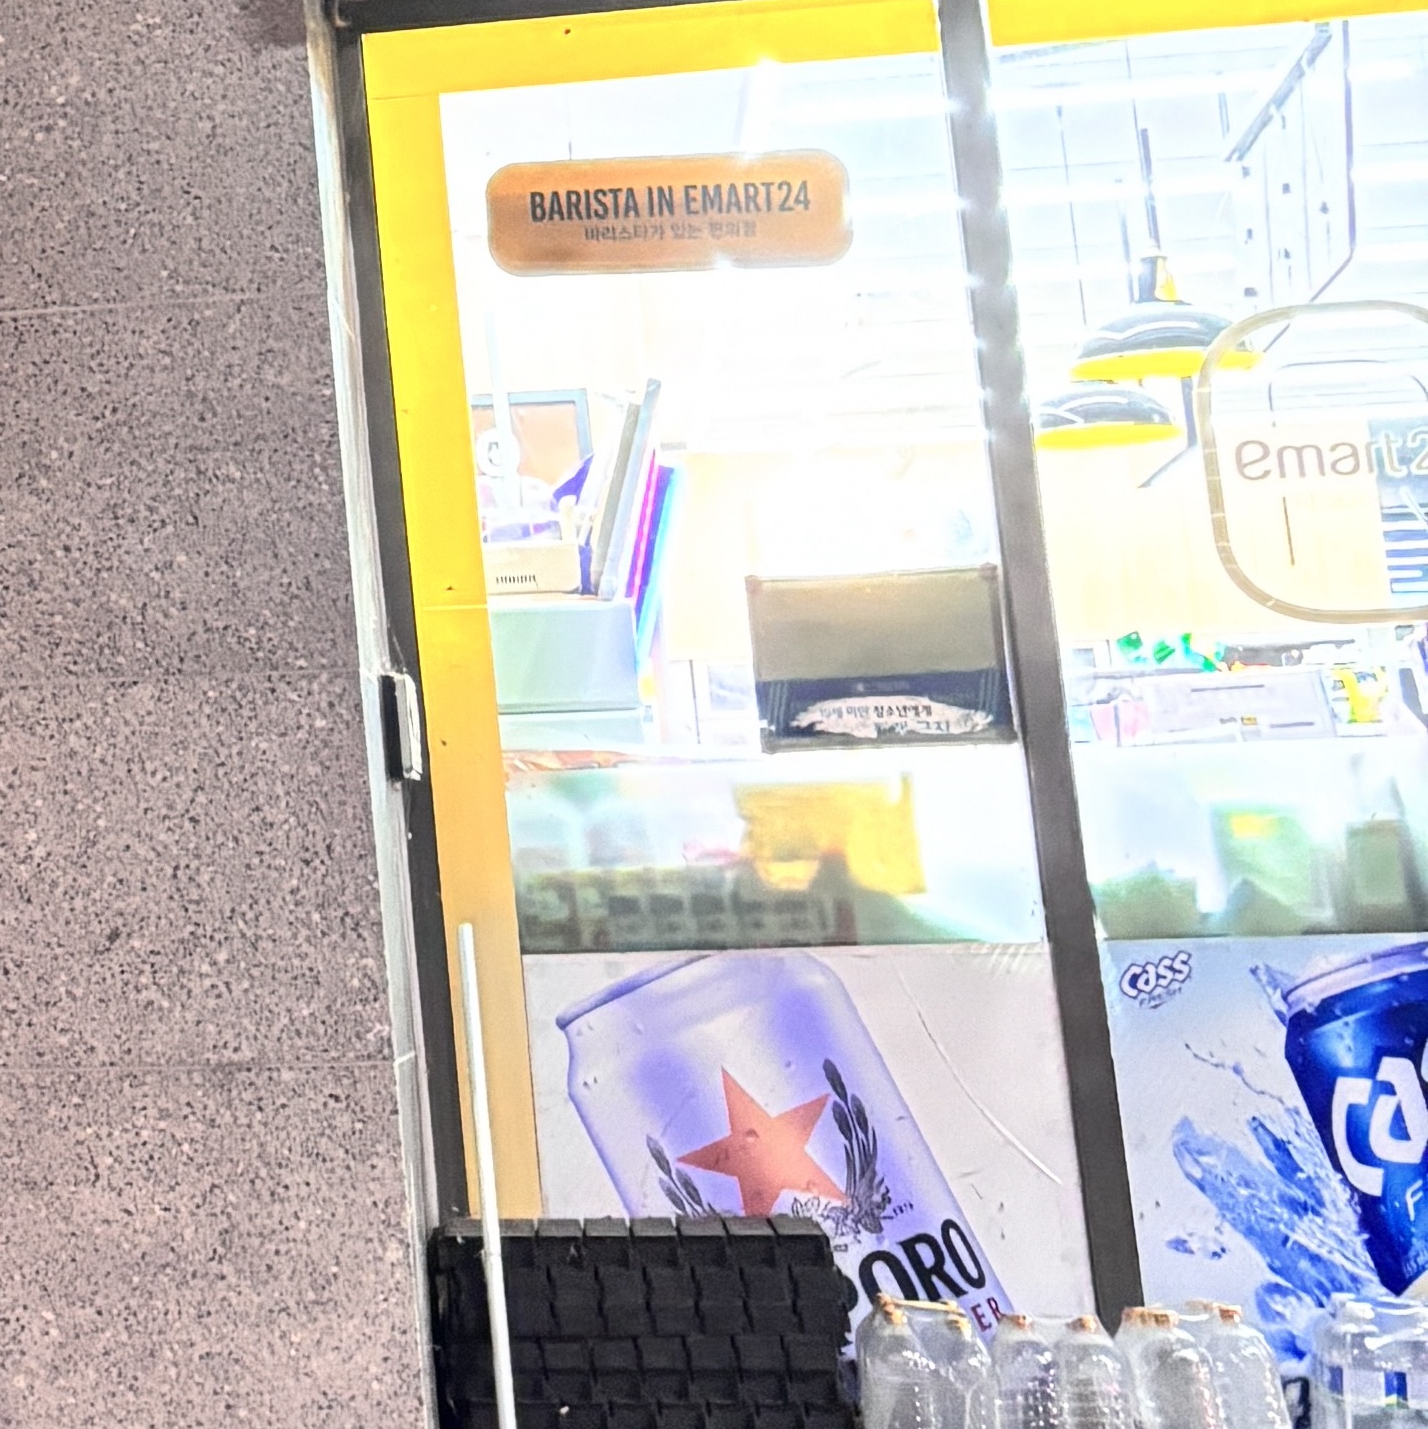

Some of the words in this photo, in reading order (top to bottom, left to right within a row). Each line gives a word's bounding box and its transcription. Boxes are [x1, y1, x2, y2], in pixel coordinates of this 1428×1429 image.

[529, 187, 641, 222] BARISTA
[647, 185, 675, 218] IN
[683, 180, 812, 216] EMART24
